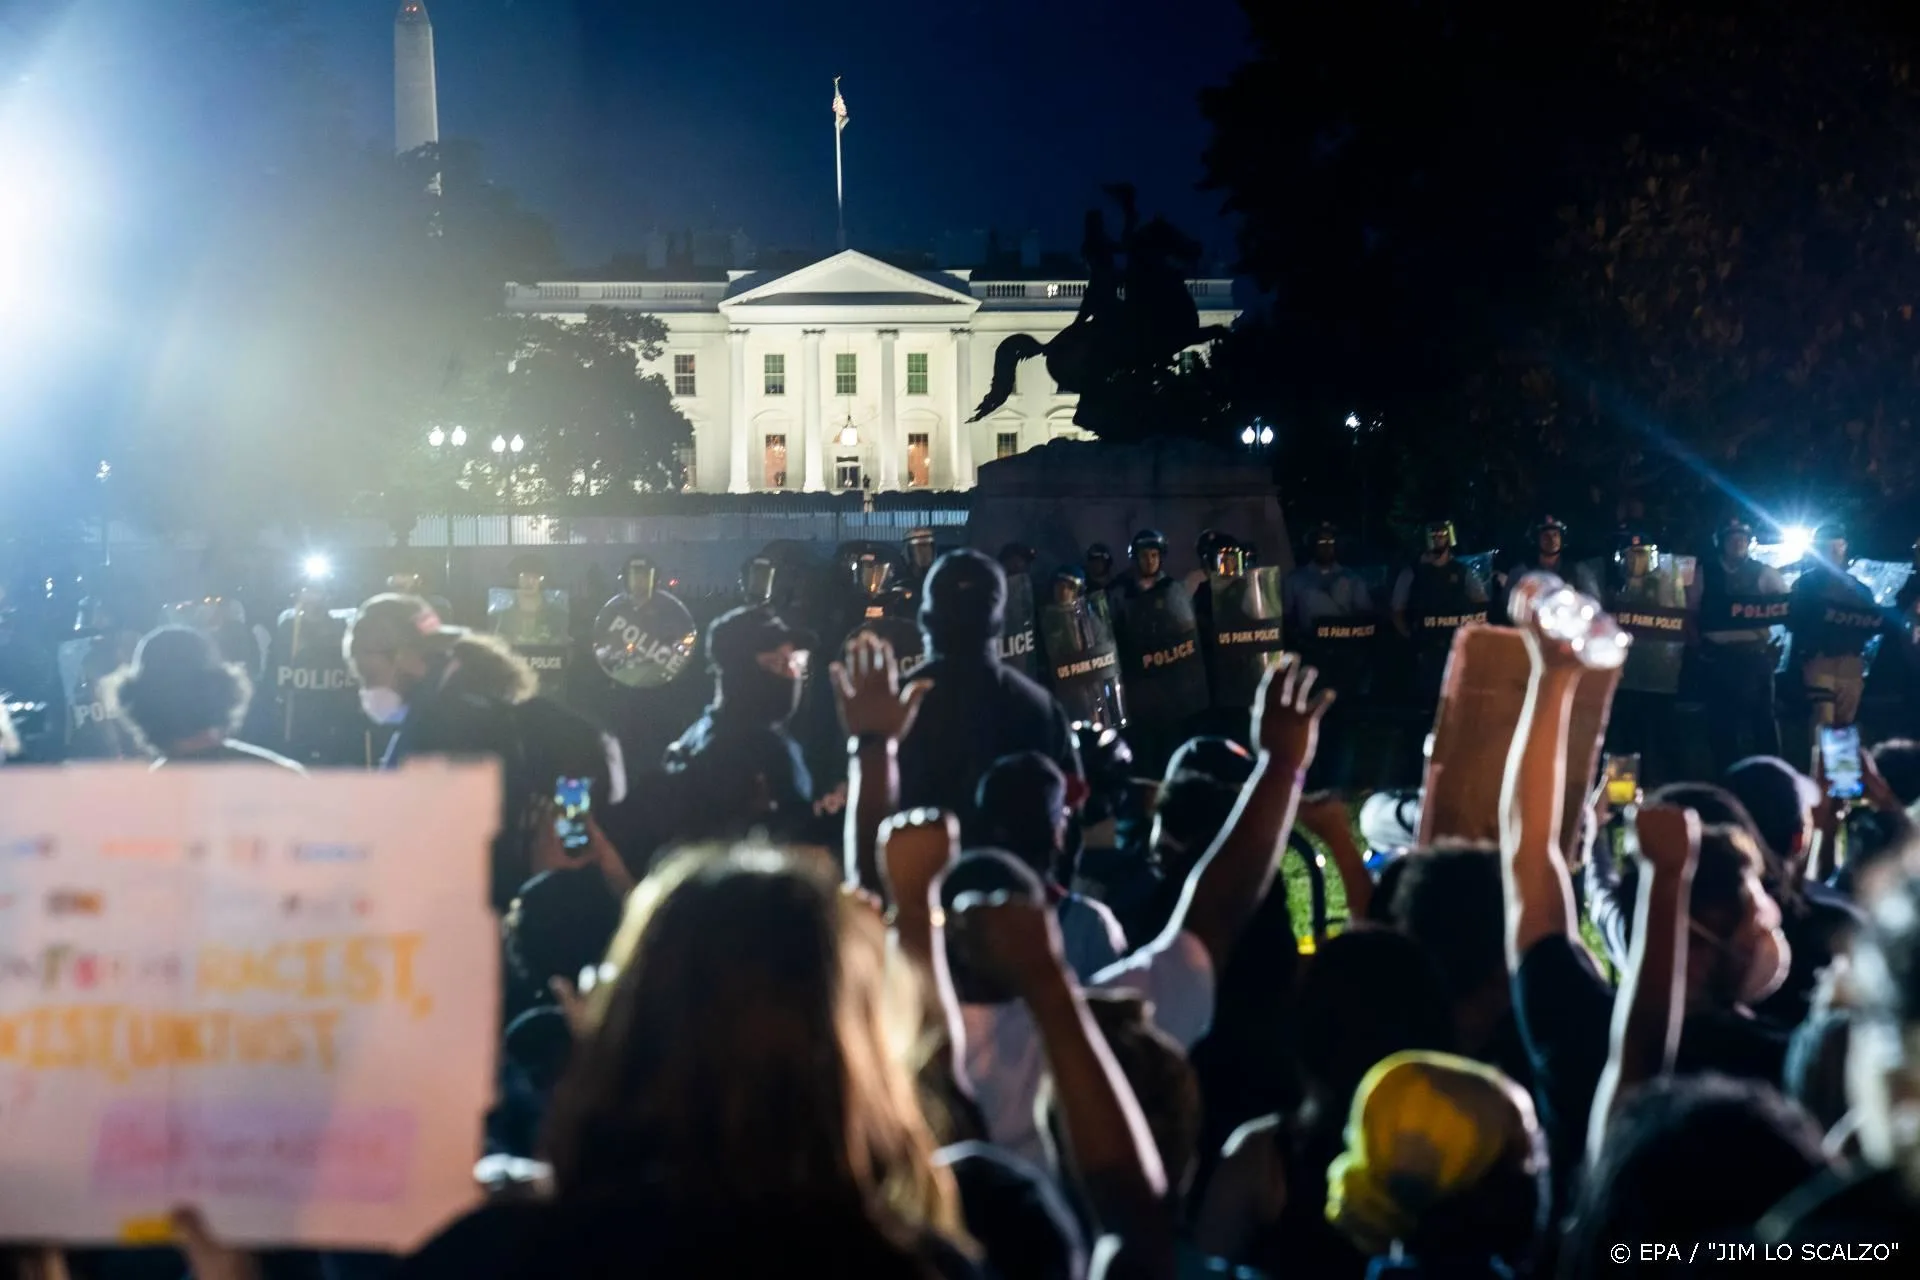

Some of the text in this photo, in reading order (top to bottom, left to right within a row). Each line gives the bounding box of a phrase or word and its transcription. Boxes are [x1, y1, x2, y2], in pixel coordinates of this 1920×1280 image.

[1731, 602, 1789, 618] POLICE
[1424, 616, 1436, 628] US
[1437, 615, 1459, 627] PARK
[1618, 612, 1683, 630] US PARK POLICE
[1218, 628, 1280, 644] US PARK POLICE
[1317, 627, 1329, 638] US
[1330, 626, 1351, 638] PARK
[608, 615, 687, 674] POLICE
[997, 630, 1034, 660] LICE
[1141, 639, 1195, 669] POLICE
[1057, 652, 1116, 679] US PARK POLICE
